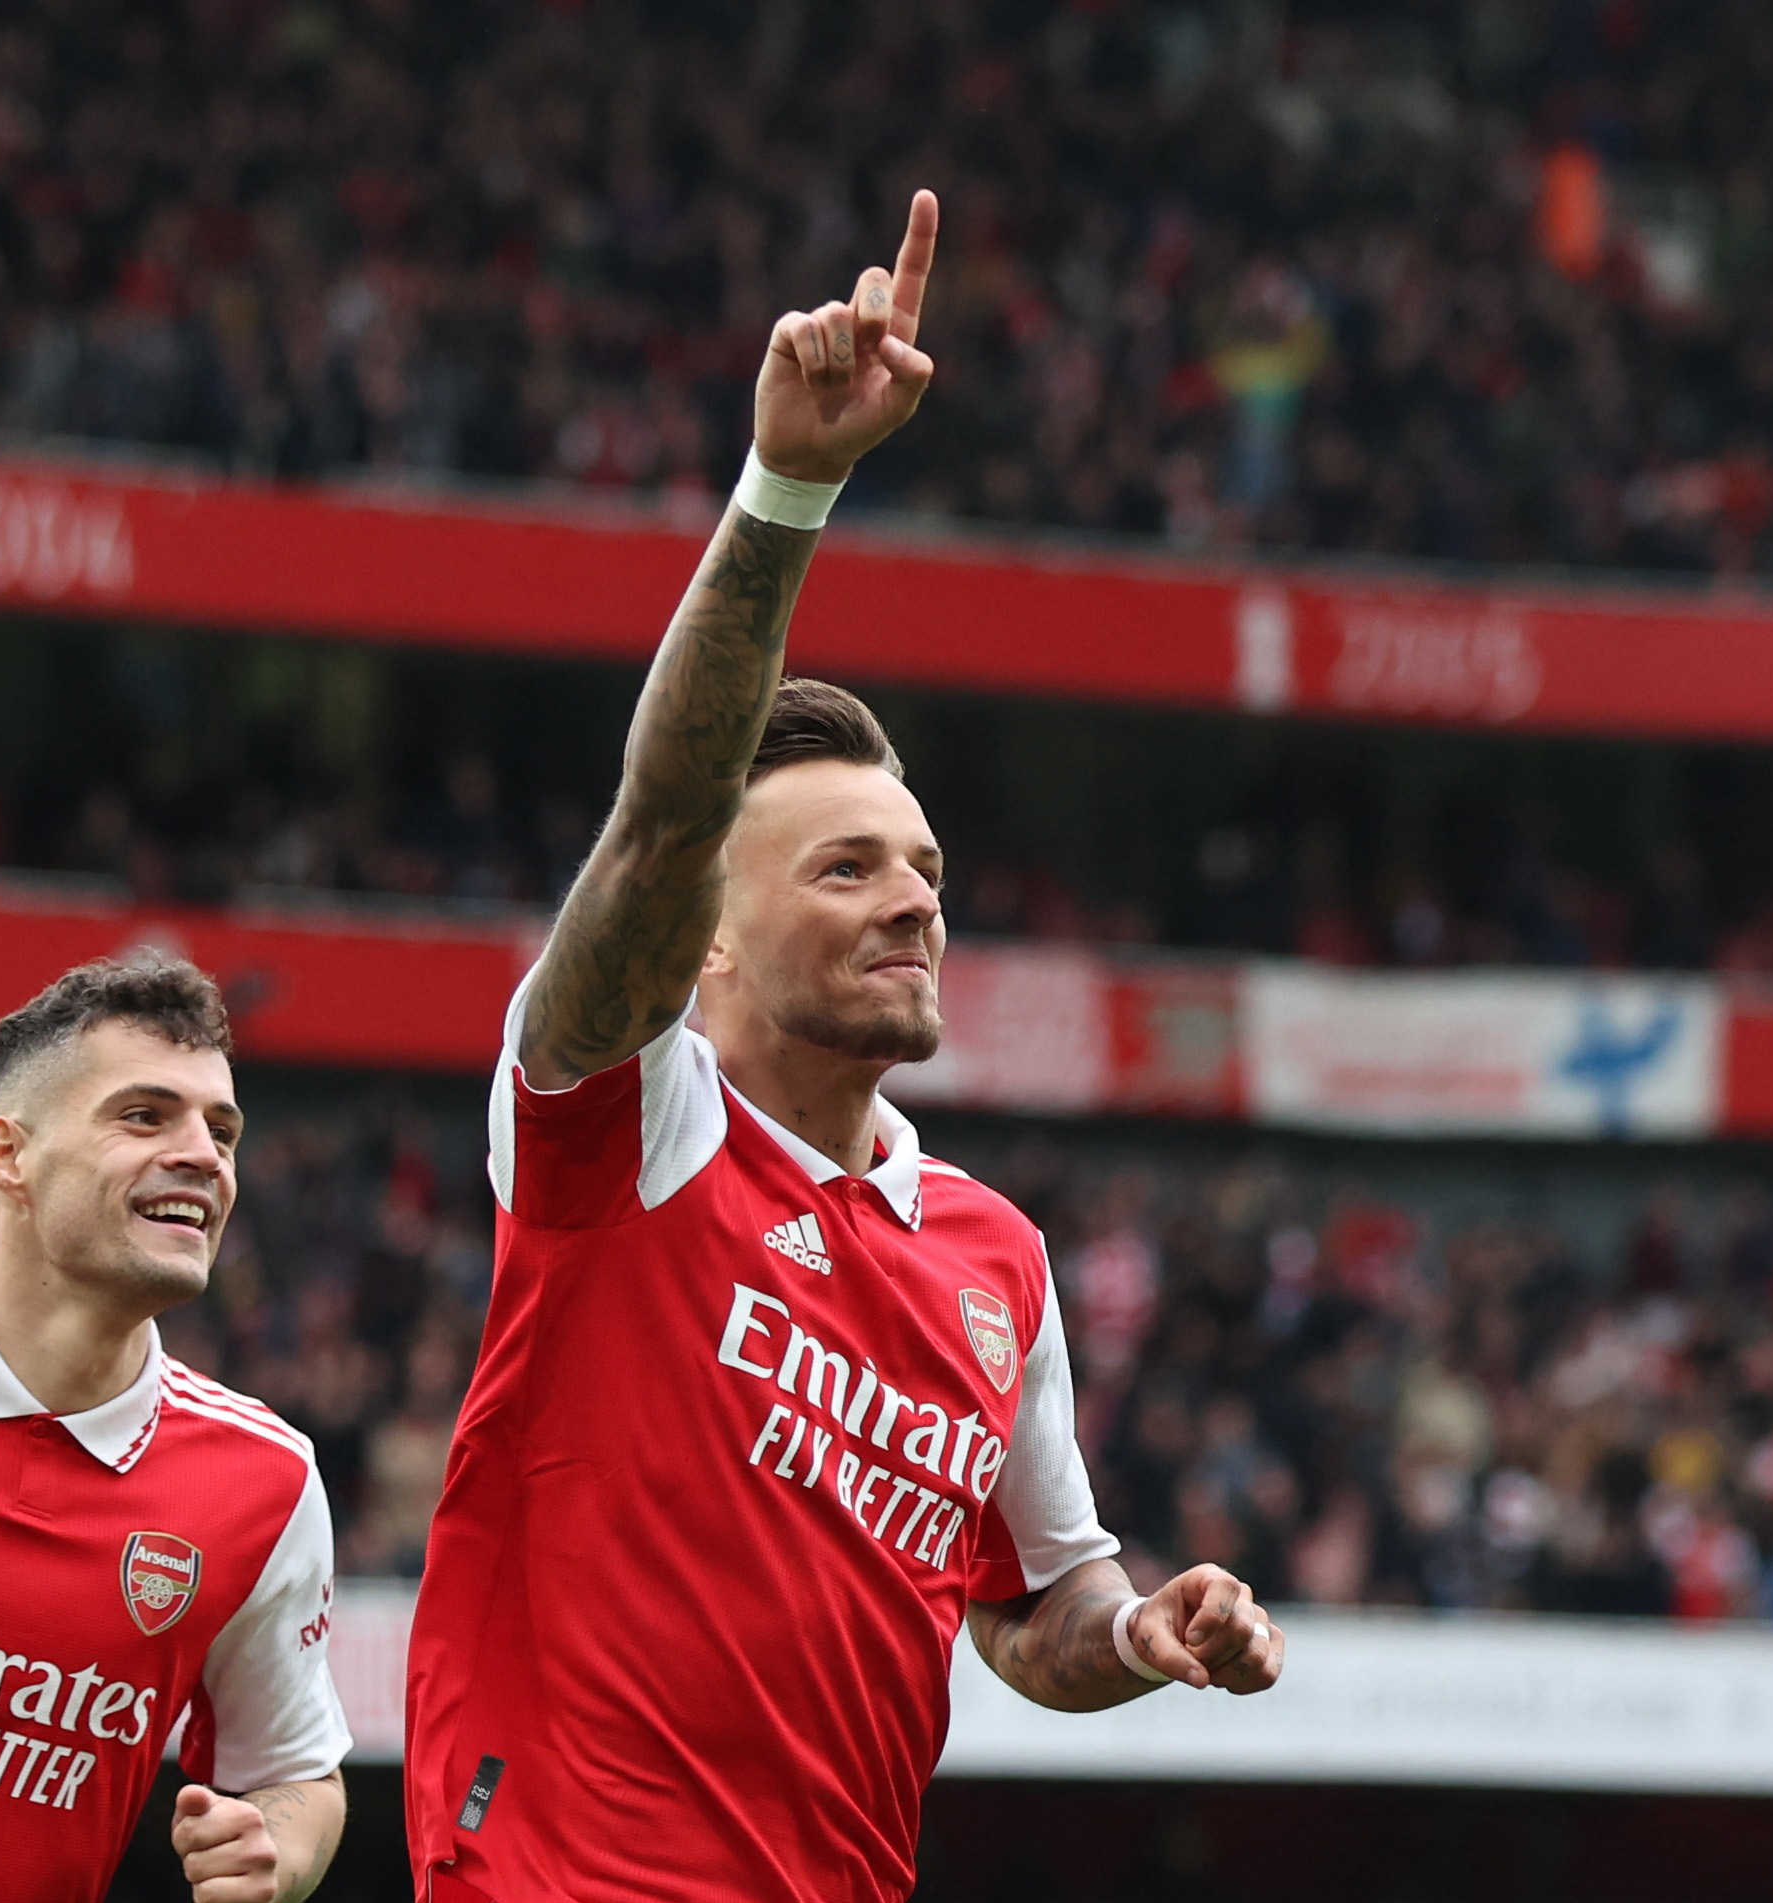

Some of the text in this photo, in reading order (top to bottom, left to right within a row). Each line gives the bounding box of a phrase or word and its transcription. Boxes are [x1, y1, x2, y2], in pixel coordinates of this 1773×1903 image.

[764, 1231, 831, 1275] adidas
[718, 1282, 1007, 1504] Emirate
[749, 1404, 965, 1571] FLY BETTER
[134, 1546, 191, 1574] Arsenal
